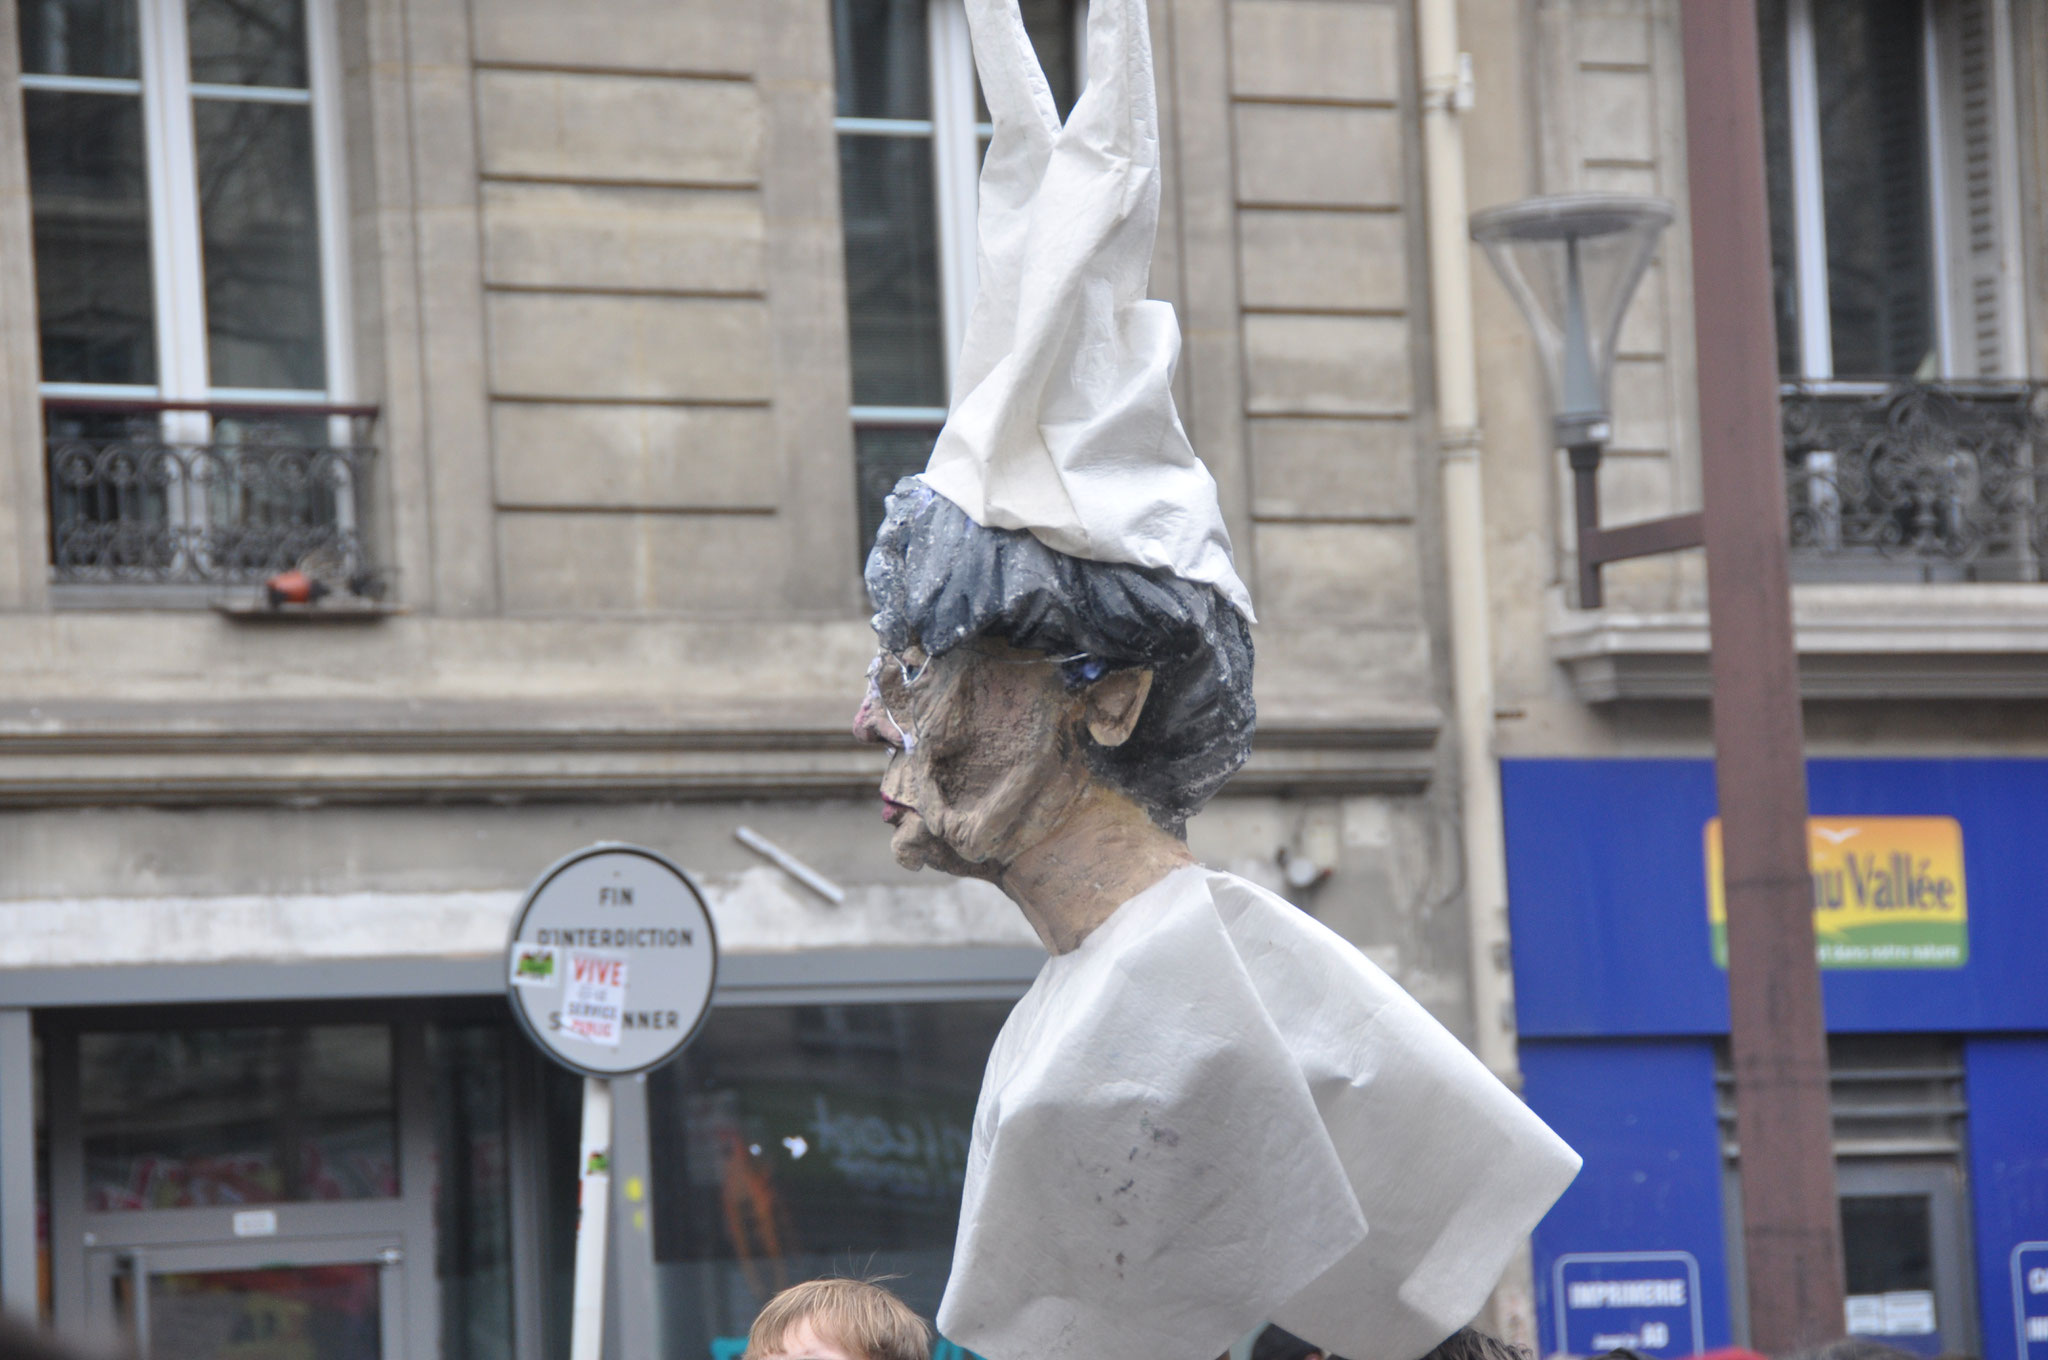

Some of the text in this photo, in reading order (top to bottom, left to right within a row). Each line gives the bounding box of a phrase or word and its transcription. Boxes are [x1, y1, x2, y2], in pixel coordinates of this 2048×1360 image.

[599, 887, 634, 905] FIN
[537, 928, 693, 946] D'INTERDICTION
[573, 957, 624, 987] VIVE
